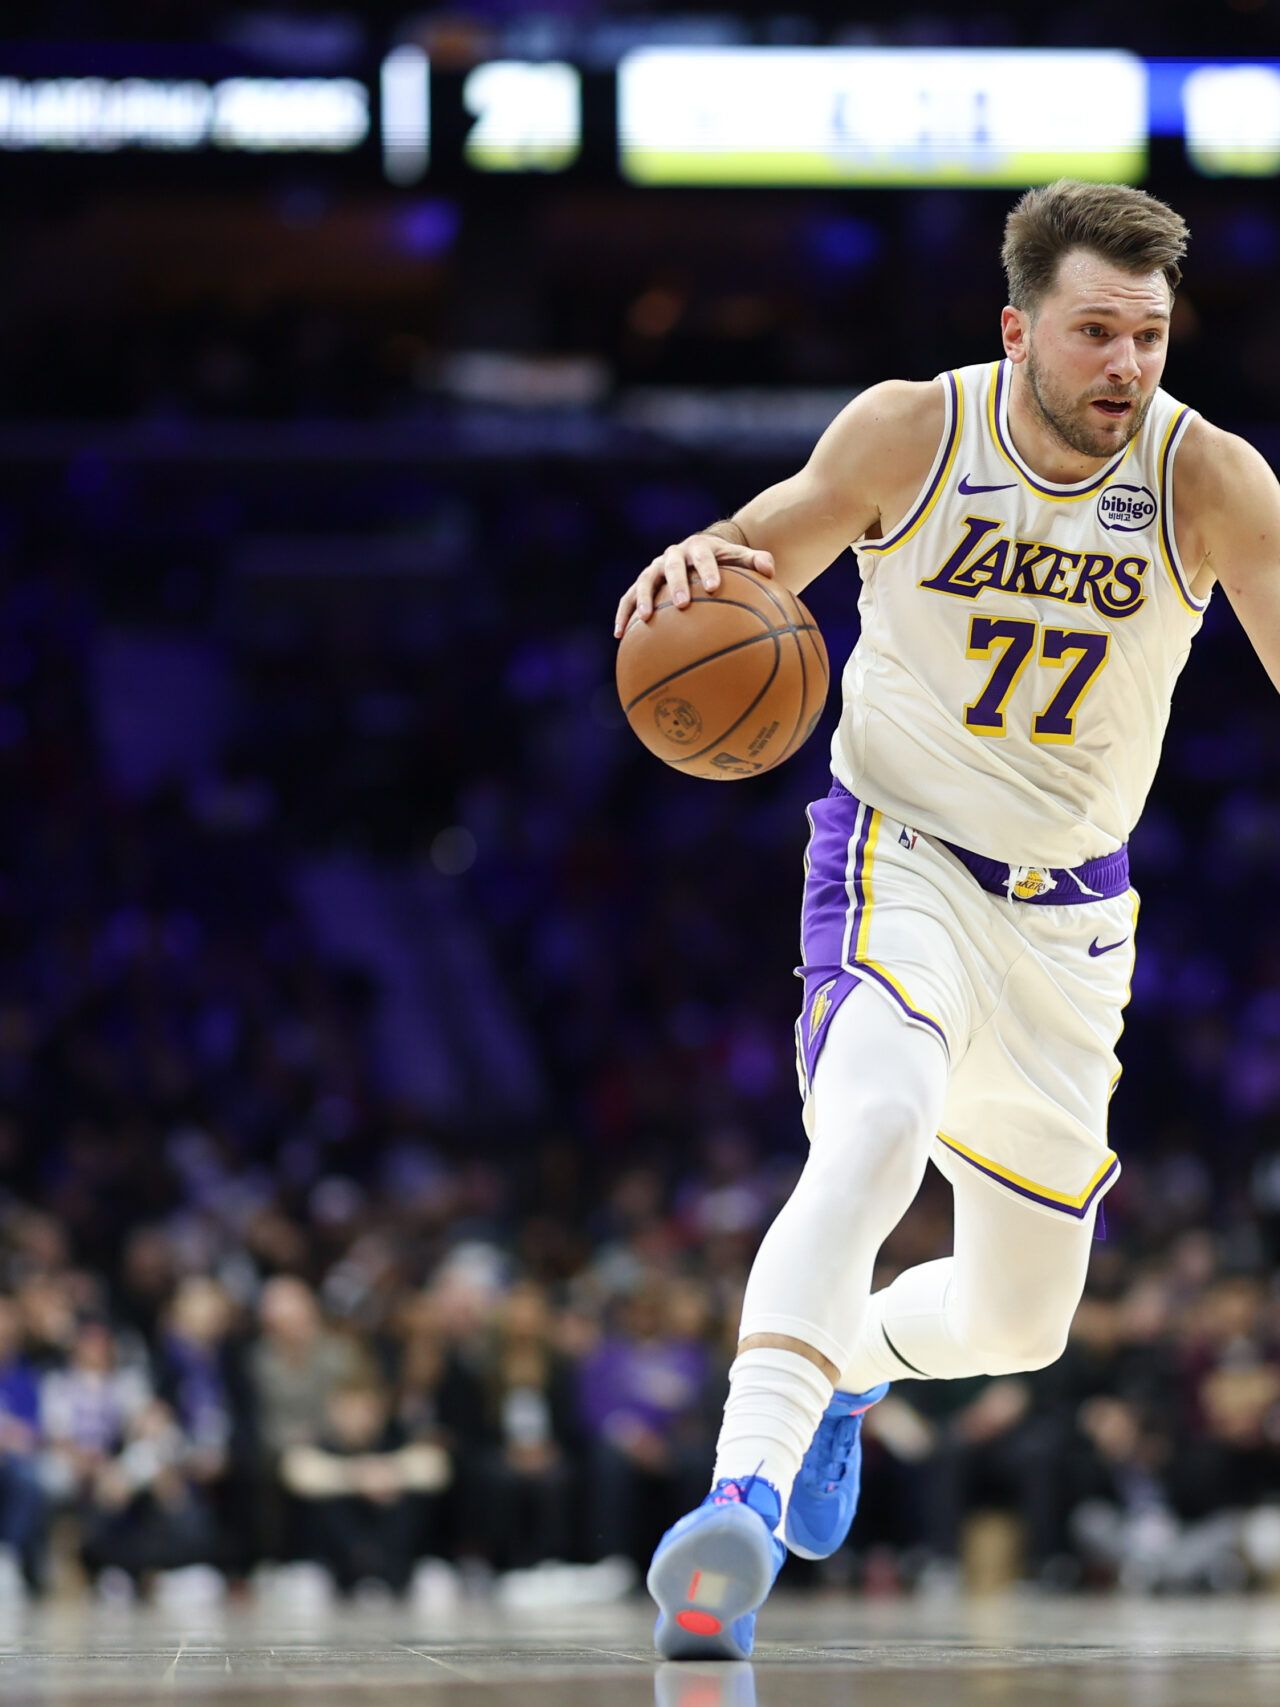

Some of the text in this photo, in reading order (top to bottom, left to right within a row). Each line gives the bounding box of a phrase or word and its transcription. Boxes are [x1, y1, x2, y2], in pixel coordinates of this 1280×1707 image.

[1101, 495, 1154, 519] bibigo
[1108, 512, 1132, 522] 비비고
[917, 514, 1151, 620] LAKERS
[963, 614, 1111, 744] 77
